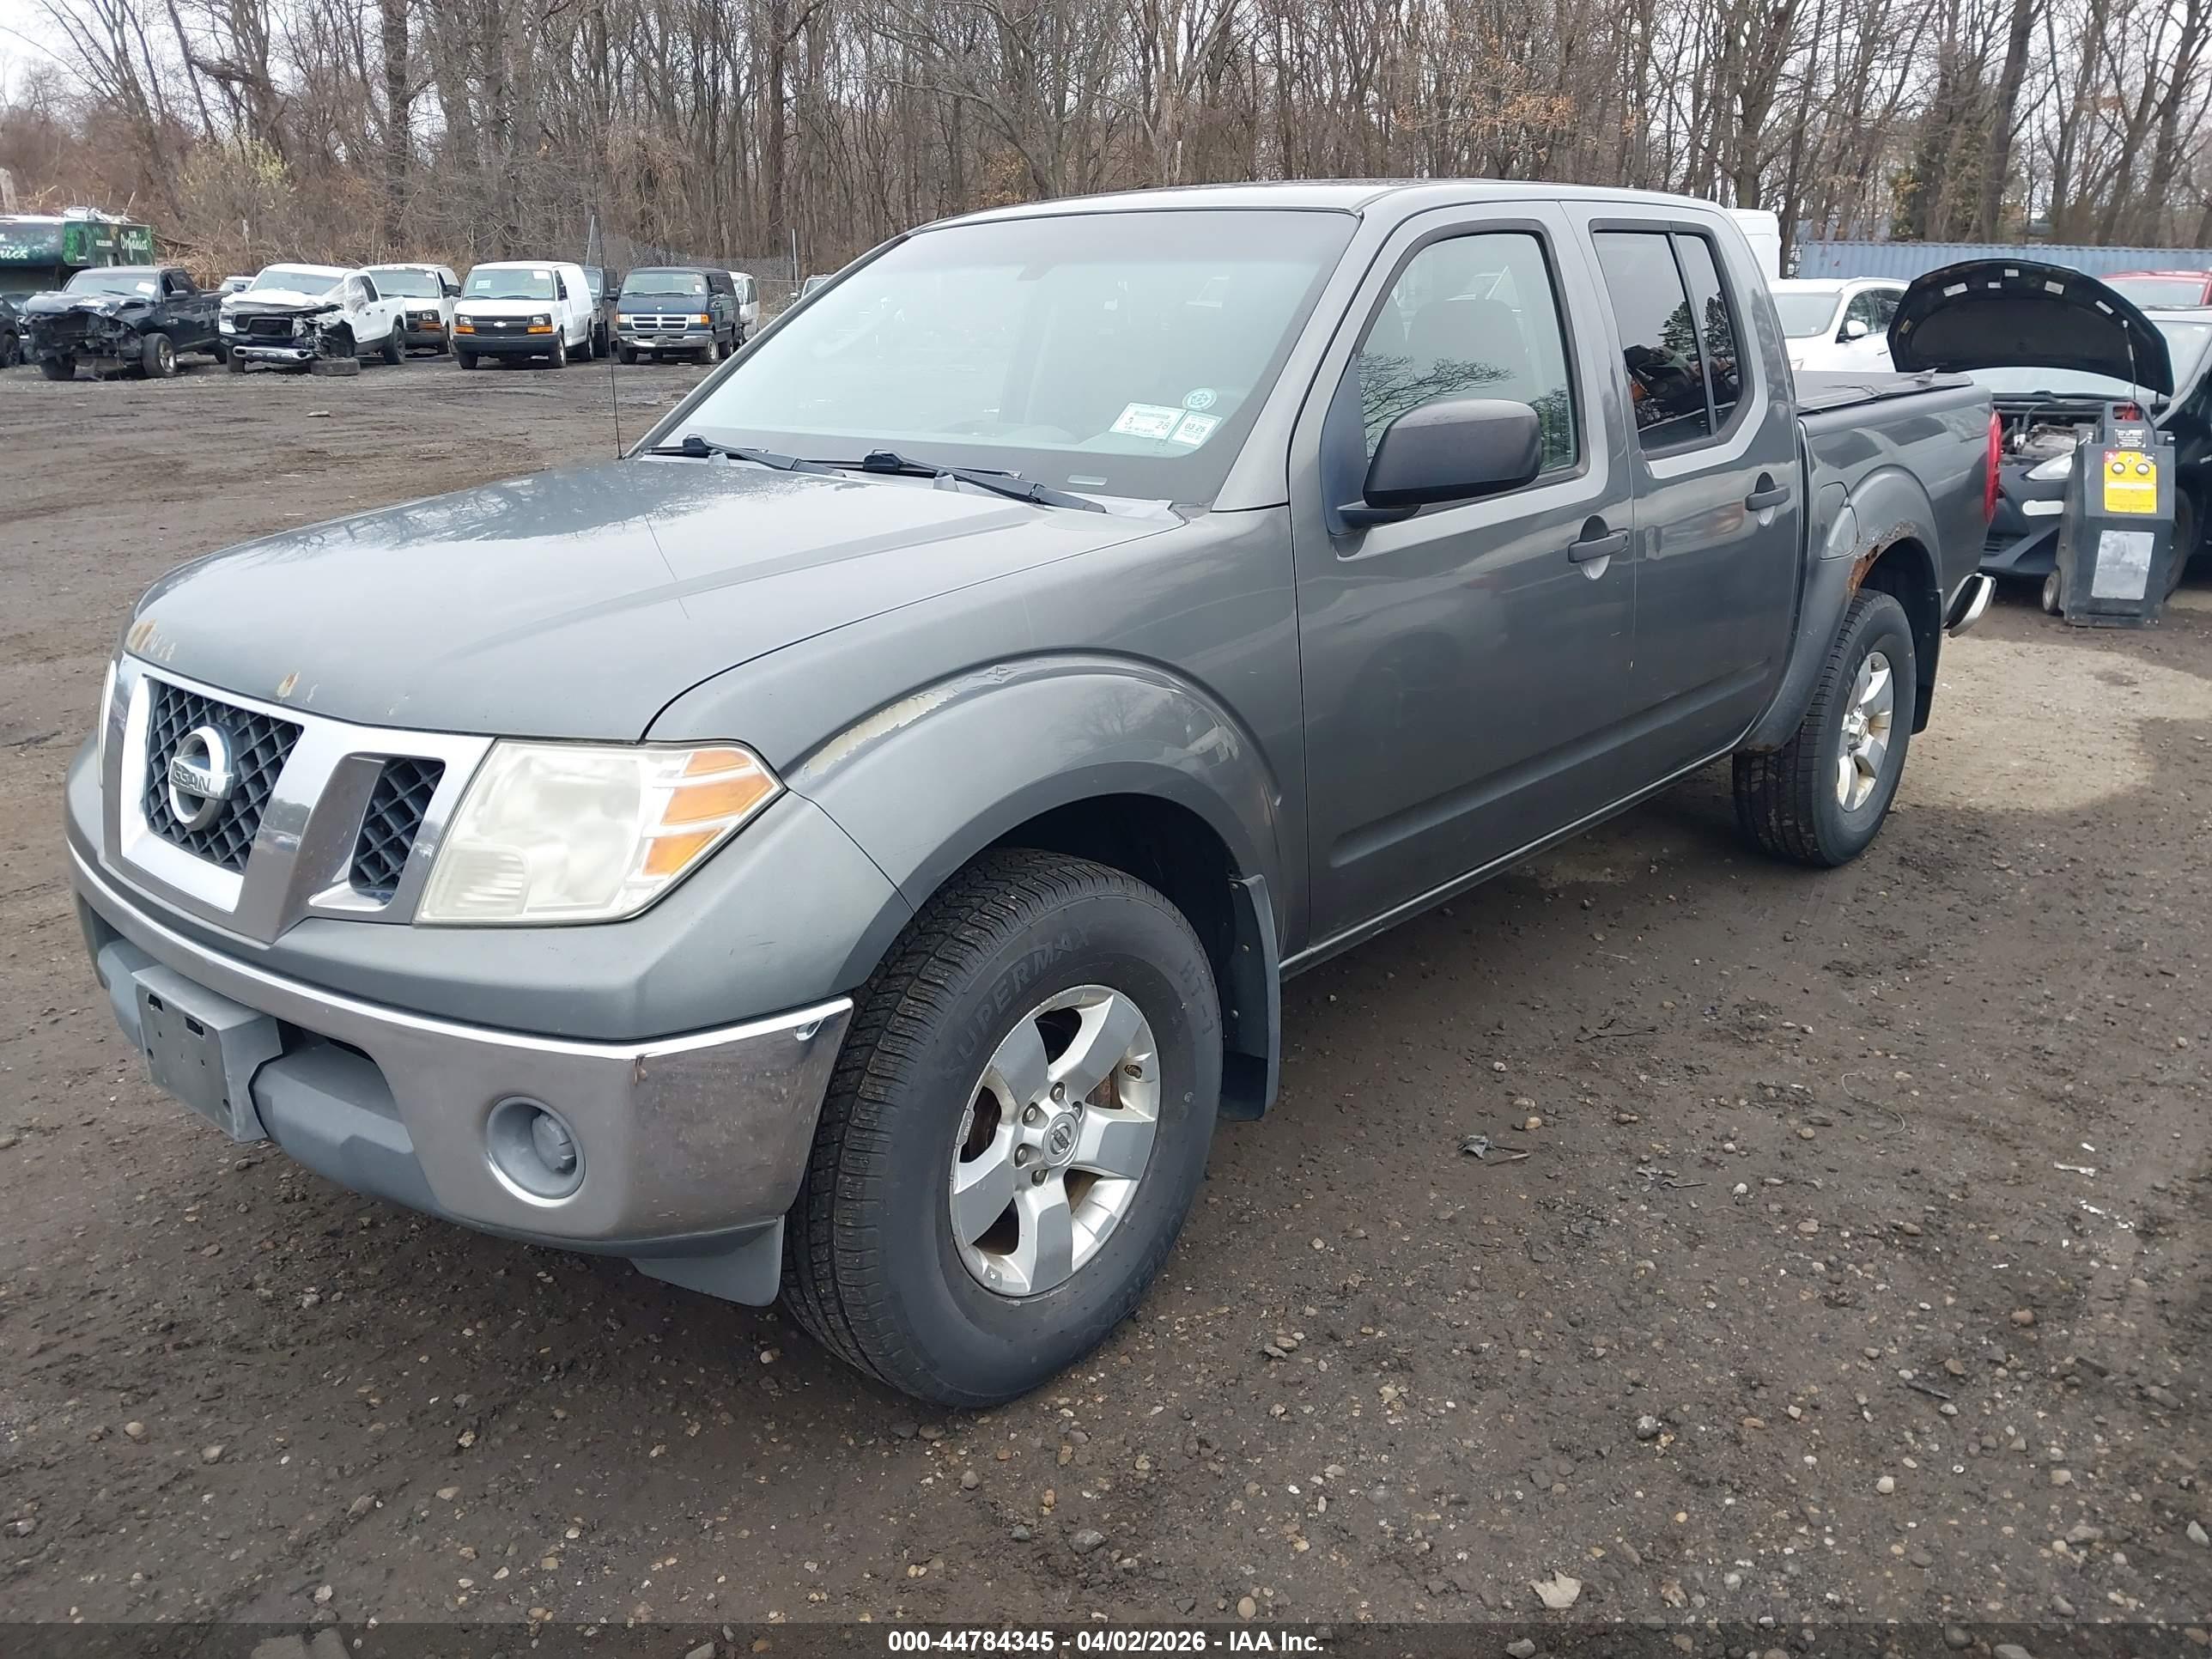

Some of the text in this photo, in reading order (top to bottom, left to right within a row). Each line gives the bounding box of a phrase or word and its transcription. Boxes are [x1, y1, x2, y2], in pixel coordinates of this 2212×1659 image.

[119, 233, 149, 261] Organics
[171, 765, 211, 793] SSAN
[945, 925, 1091, 1082] SUPERMAX
